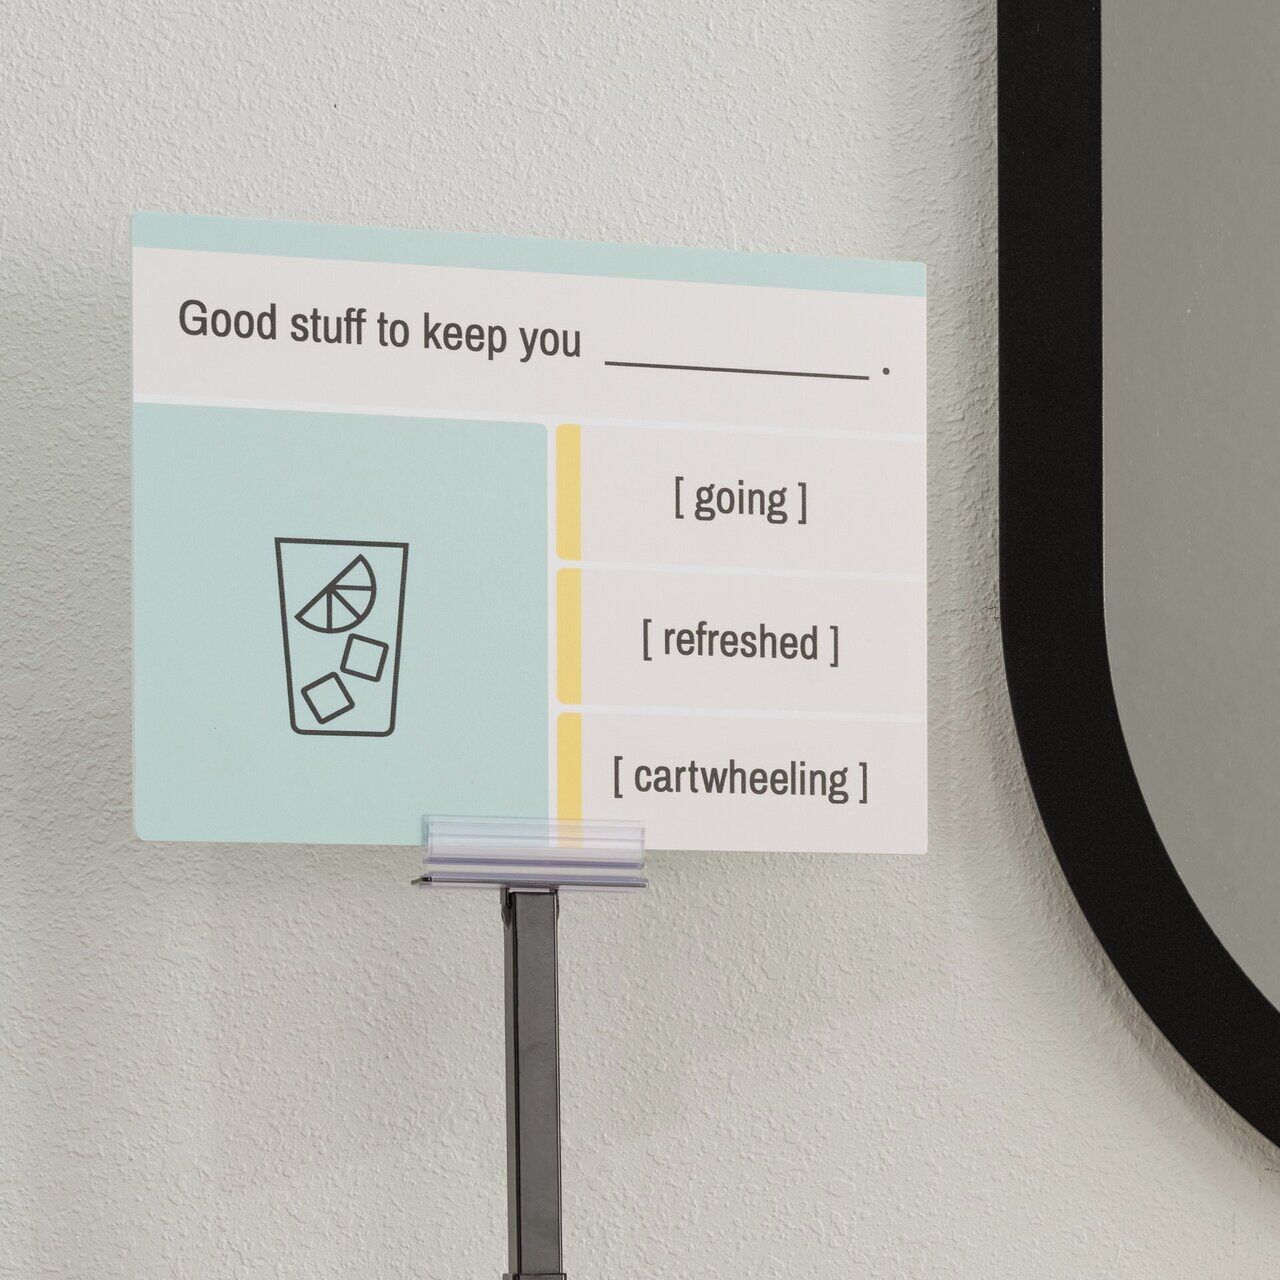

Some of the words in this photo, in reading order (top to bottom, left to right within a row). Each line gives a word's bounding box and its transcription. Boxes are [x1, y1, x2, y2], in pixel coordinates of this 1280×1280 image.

[178, 299, 277, 340] Good
[290, 307, 367, 345] stuff
[376, 311, 410, 348] to
[423, 311, 507, 361] keep
[518, 327, 581, 363] you
[694, 479, 788, 525] going
[664, 620, 818, 660] refreshed
[634, 758, 849, 805] cartwheeling
